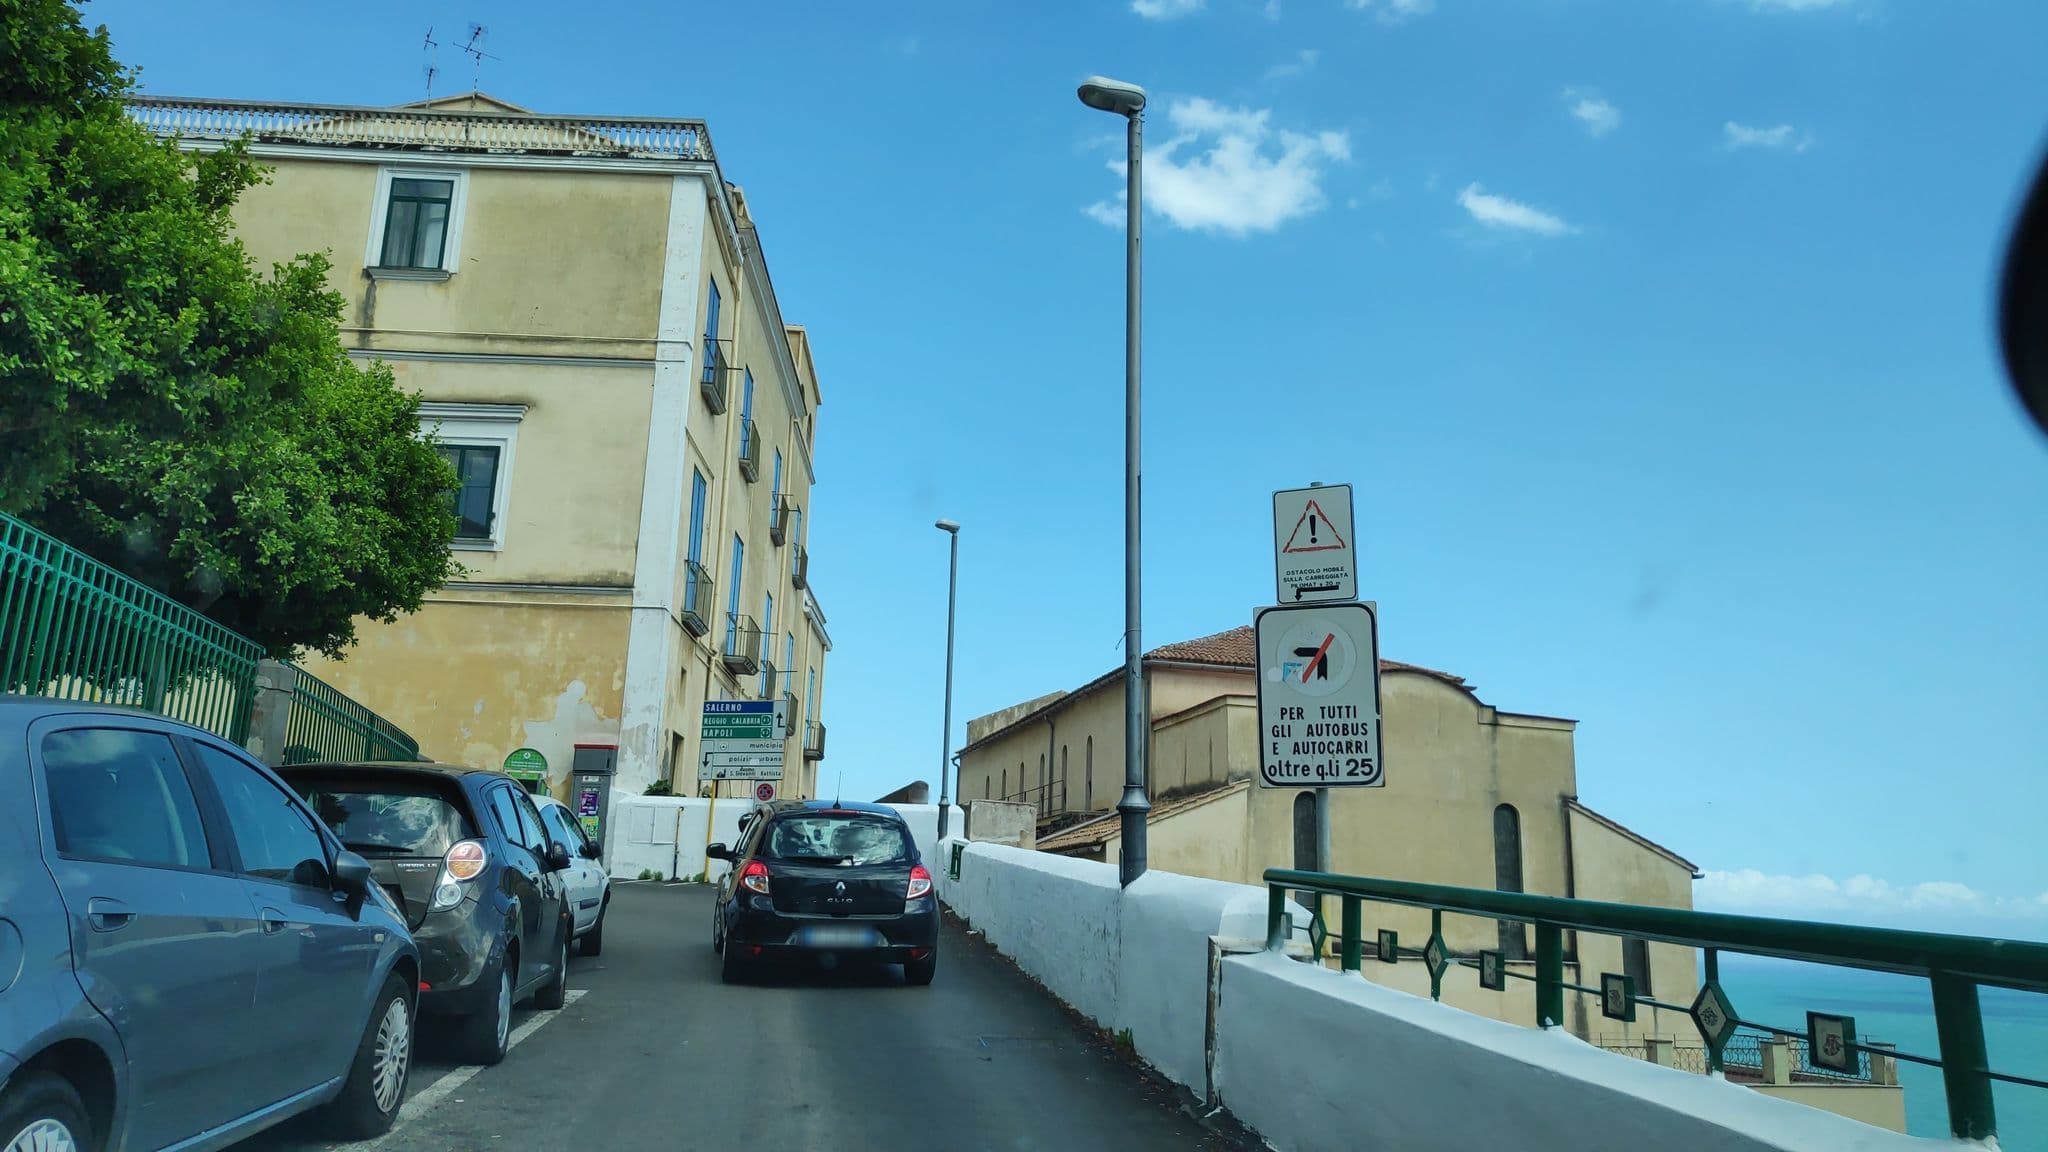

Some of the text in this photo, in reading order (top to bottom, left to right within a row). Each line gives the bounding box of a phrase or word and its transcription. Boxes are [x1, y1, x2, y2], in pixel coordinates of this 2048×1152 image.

[1286, 568, 1321, 576] OSTACOLO
[1305, 572, 1348, 581] CARREGGIATA
[705, 703, 742, 712] SALERNO
[1280, 705, 1357, 720] PER TUTTI
[703, 717, 727, 725] REGGIO
[731, 717, 760, 725] CALABRIA
[703, 729, 733, 737] NAPOLI
[1271, 722, 1368, 738] GLI AUTOBUS
[749, 742, 783, 750] municipio
[1272, 740, 1369, 755] E AUTOCARRI
[1268, 758, 1374, 780] oltre q.li 25
